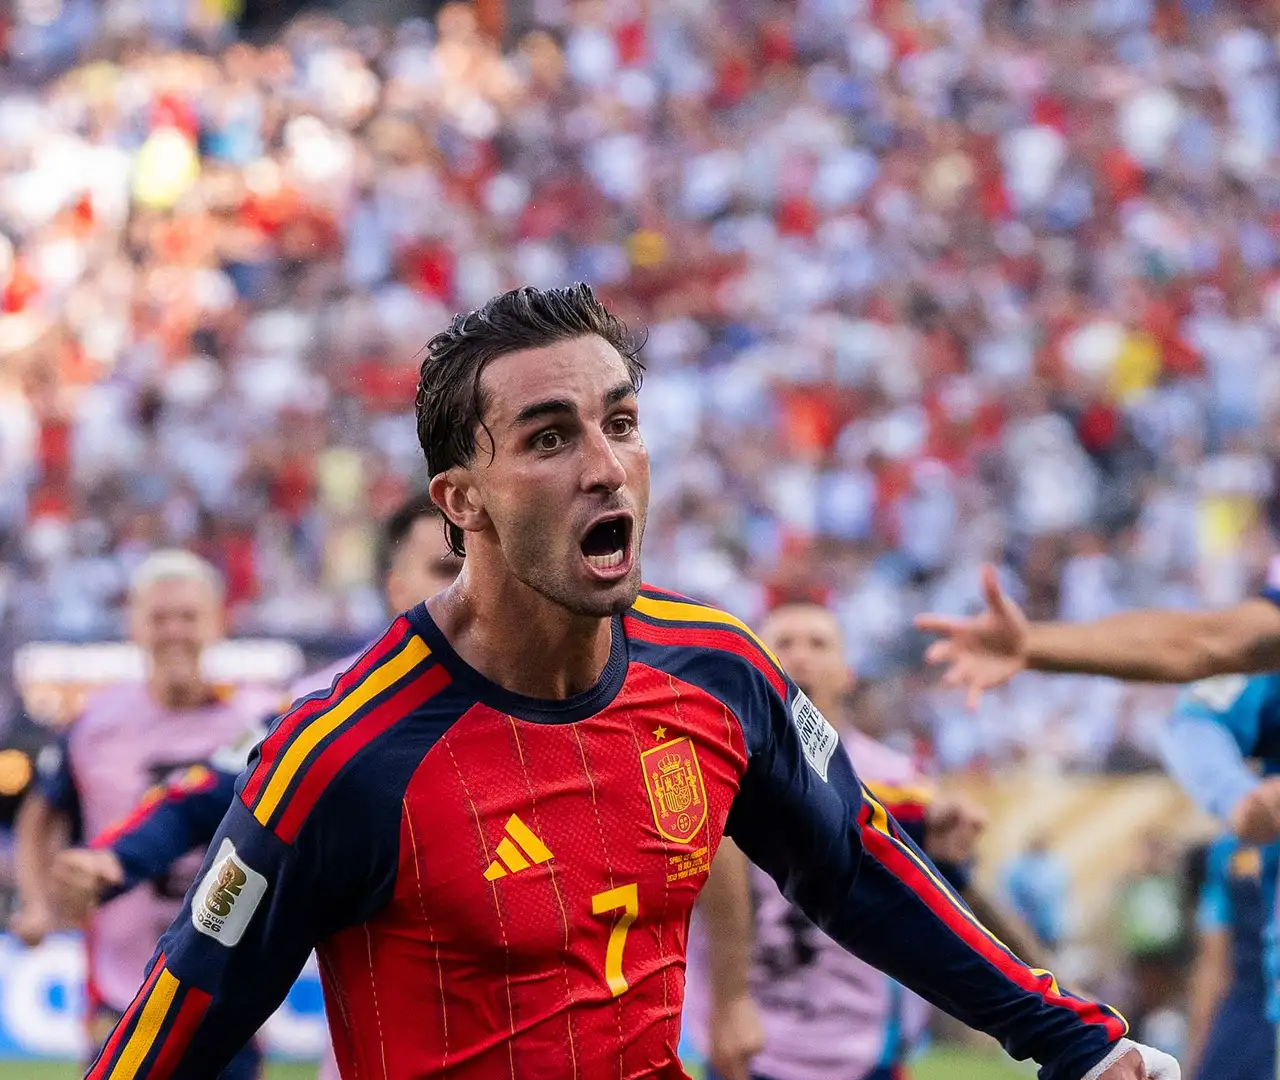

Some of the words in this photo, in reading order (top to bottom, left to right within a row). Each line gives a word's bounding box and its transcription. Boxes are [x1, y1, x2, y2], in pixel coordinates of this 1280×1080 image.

[800, 708, 819, 746] UNITE
[196, 911, 221, 933] 026
[591, 883, 639, 998] 7
